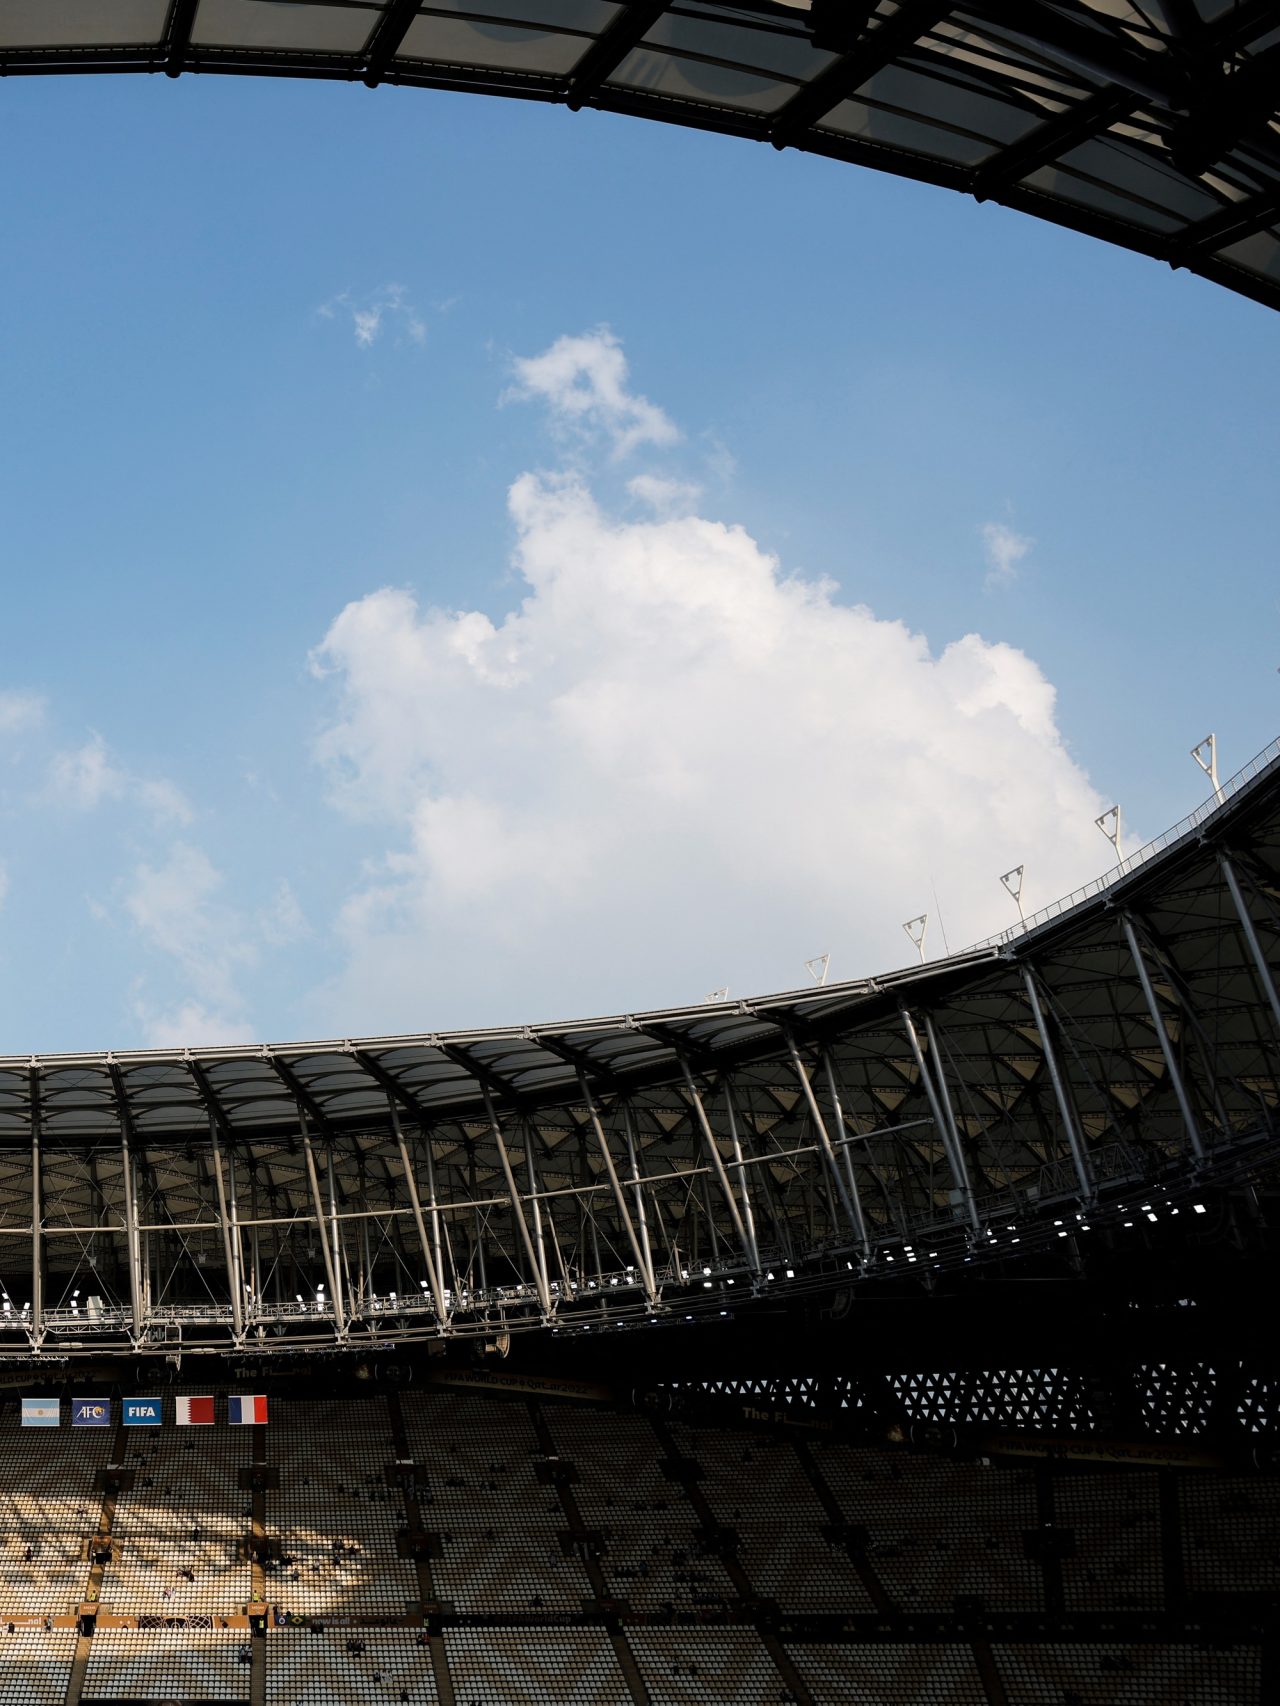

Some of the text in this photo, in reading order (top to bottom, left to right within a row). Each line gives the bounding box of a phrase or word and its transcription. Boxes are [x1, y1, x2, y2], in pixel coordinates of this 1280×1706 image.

[234, 1367, 257, 1379] The
[76, 1406, 106, 1419] AFC
[128, 1406, 156, 1417] FIFA
[741, 1406, 769, 1420] The
[340, 1616, 350, 1625] all
